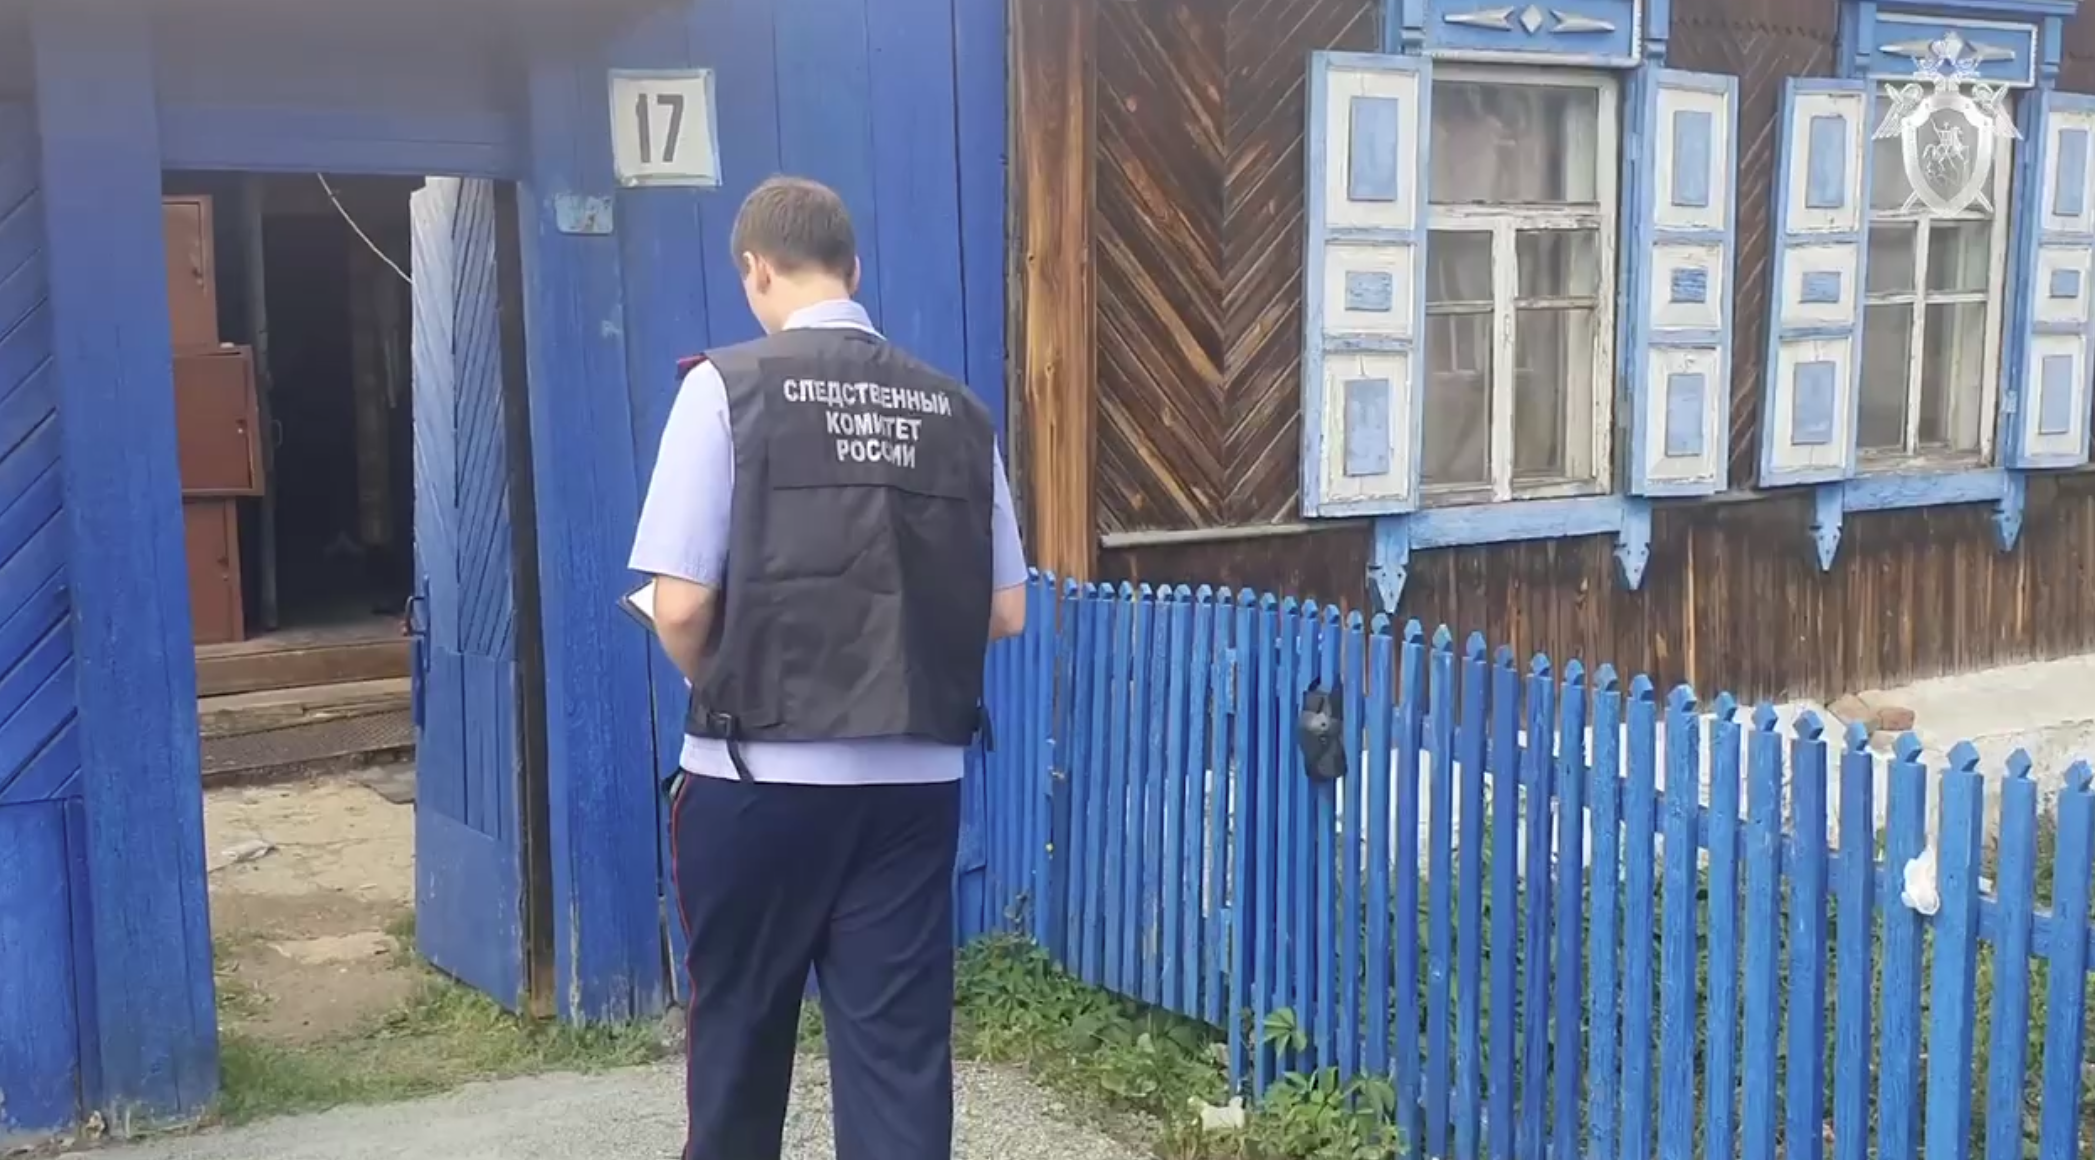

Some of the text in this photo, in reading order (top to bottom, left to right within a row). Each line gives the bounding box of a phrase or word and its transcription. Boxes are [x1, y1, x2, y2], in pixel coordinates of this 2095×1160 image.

[636, 93, 684, 163] 17
[783, 379, 952, 416] СЛЕДСТВЕННЫЙ
[825, 411, 922, 441] КОМИТЕТ
[836, 439, 916, 468] РОССИИ
